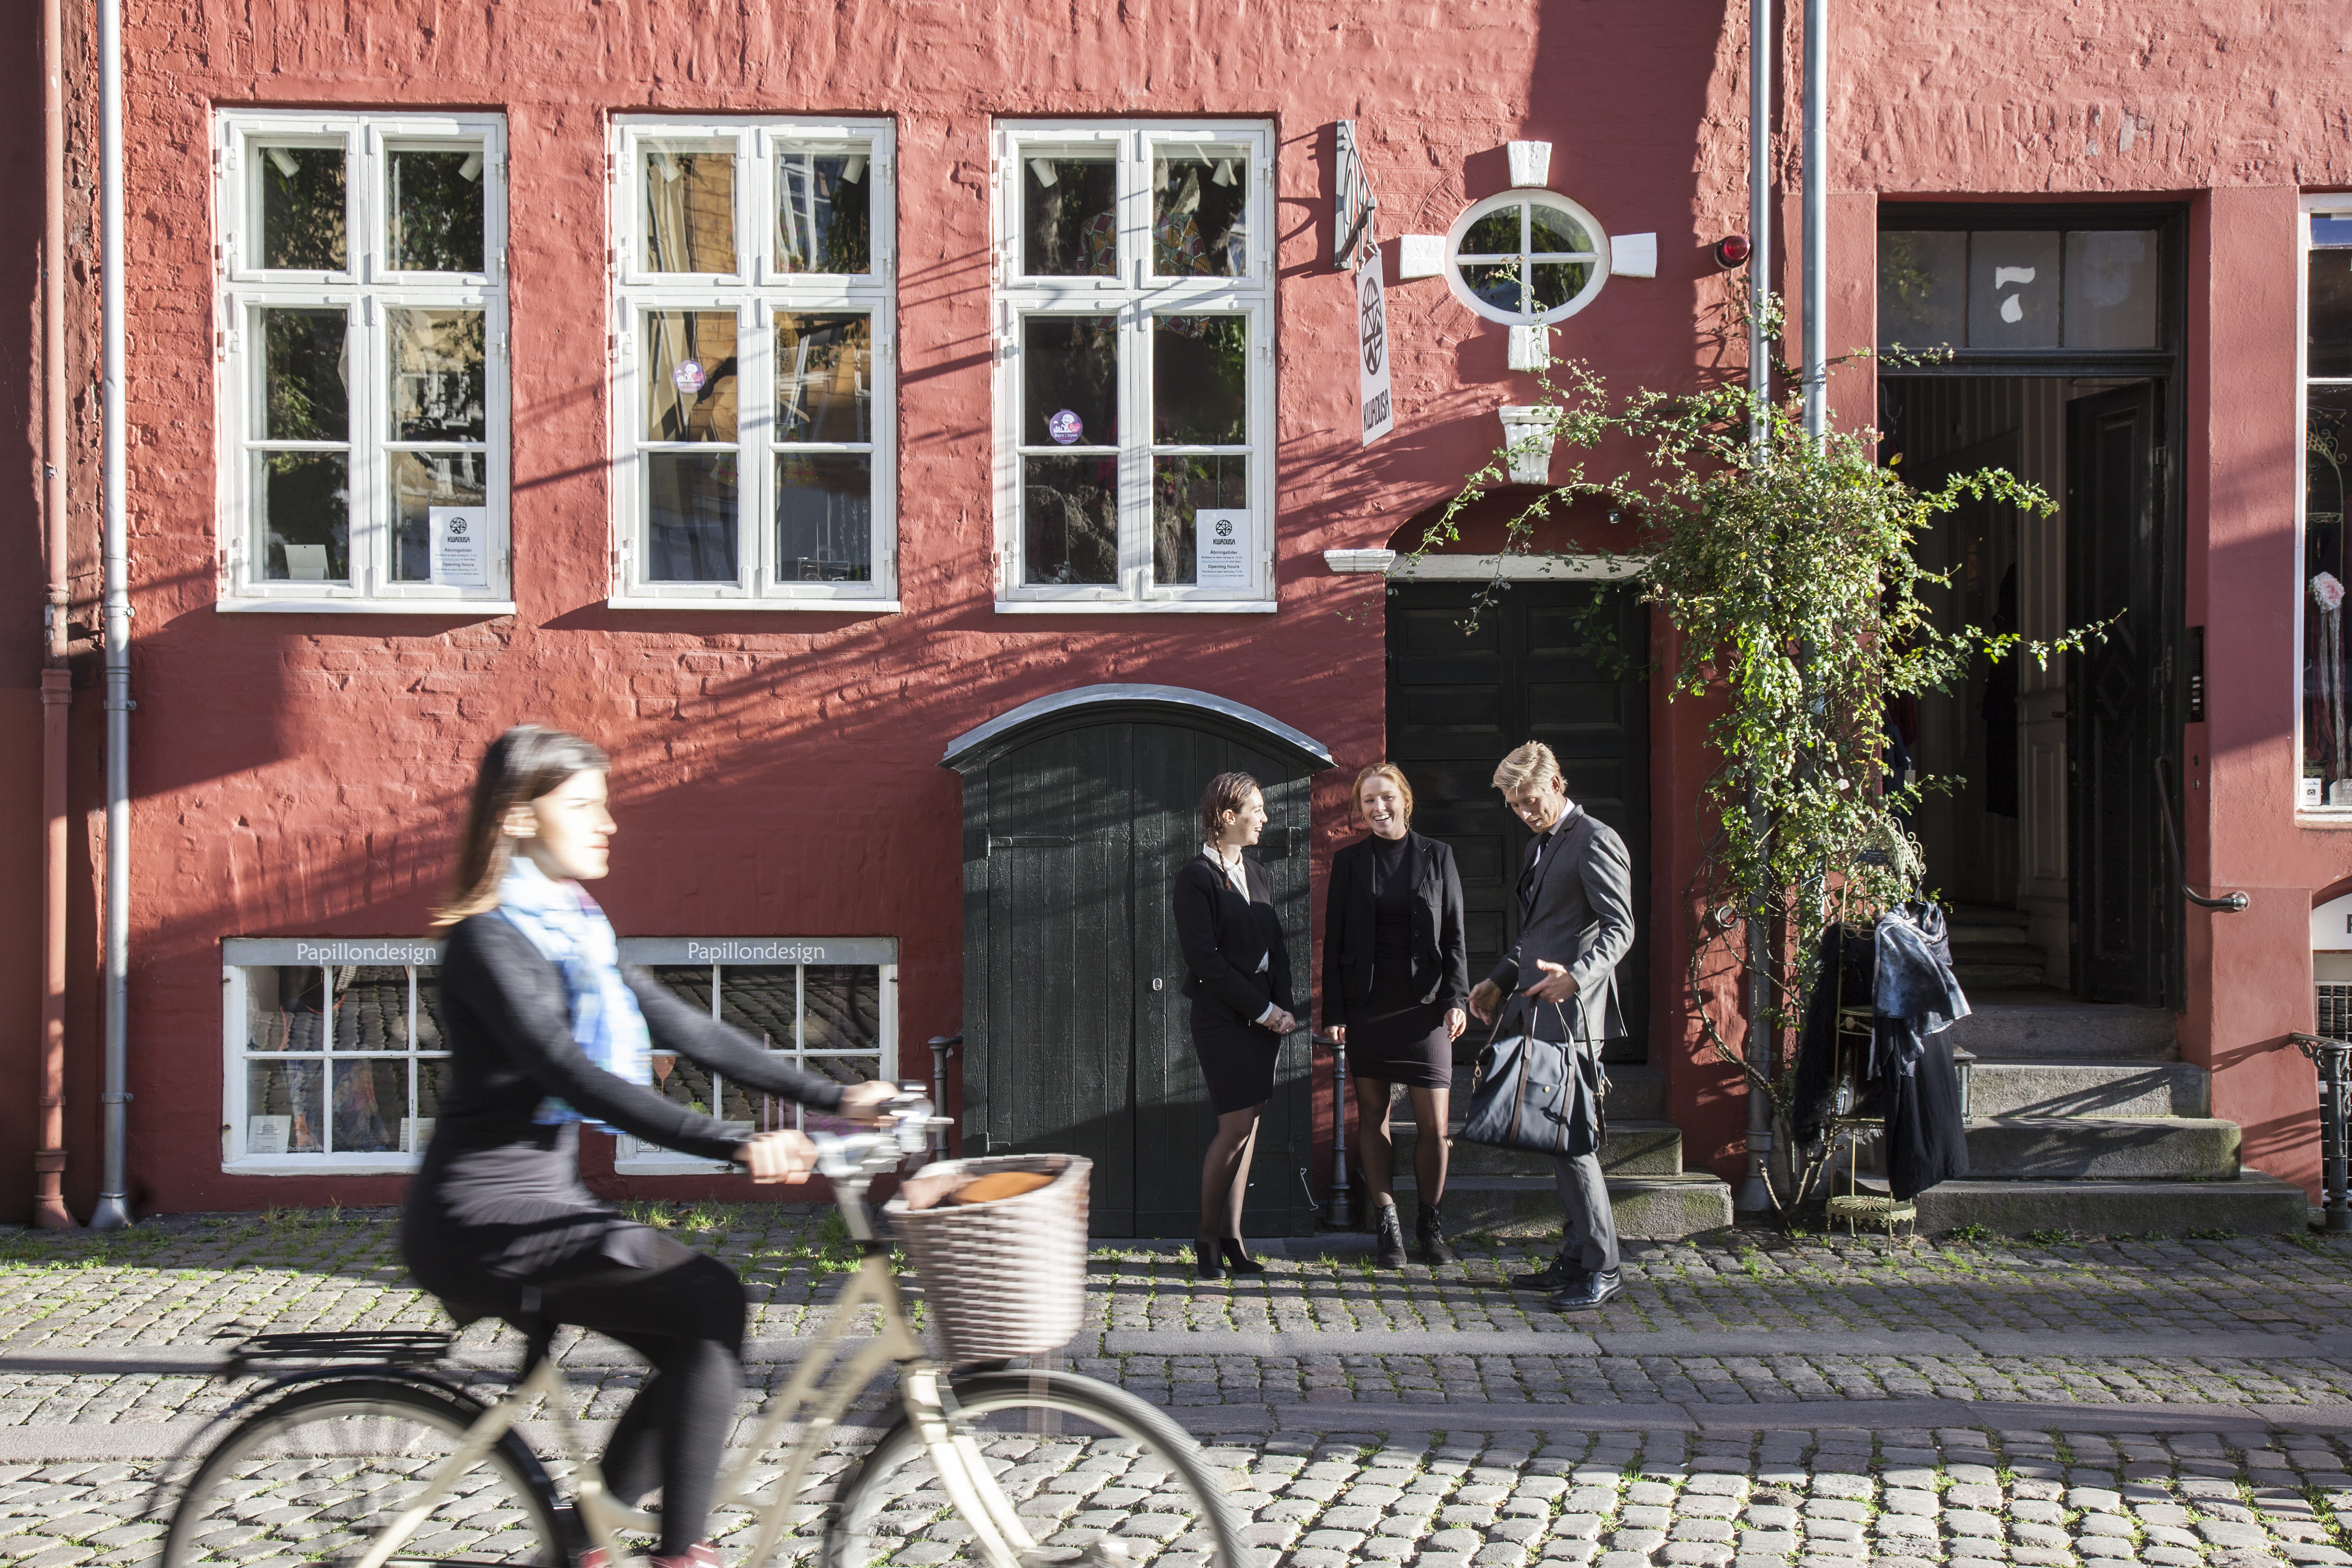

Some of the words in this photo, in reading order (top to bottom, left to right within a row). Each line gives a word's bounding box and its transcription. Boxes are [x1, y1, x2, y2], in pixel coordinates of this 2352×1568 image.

[1995, 266, 2036, 323] 7
[1363, 388, 1390, 433] KWADUSA
[297, 943, 436, 964] Papillondesign
[688, 942, 825, 963] Papillondesign
